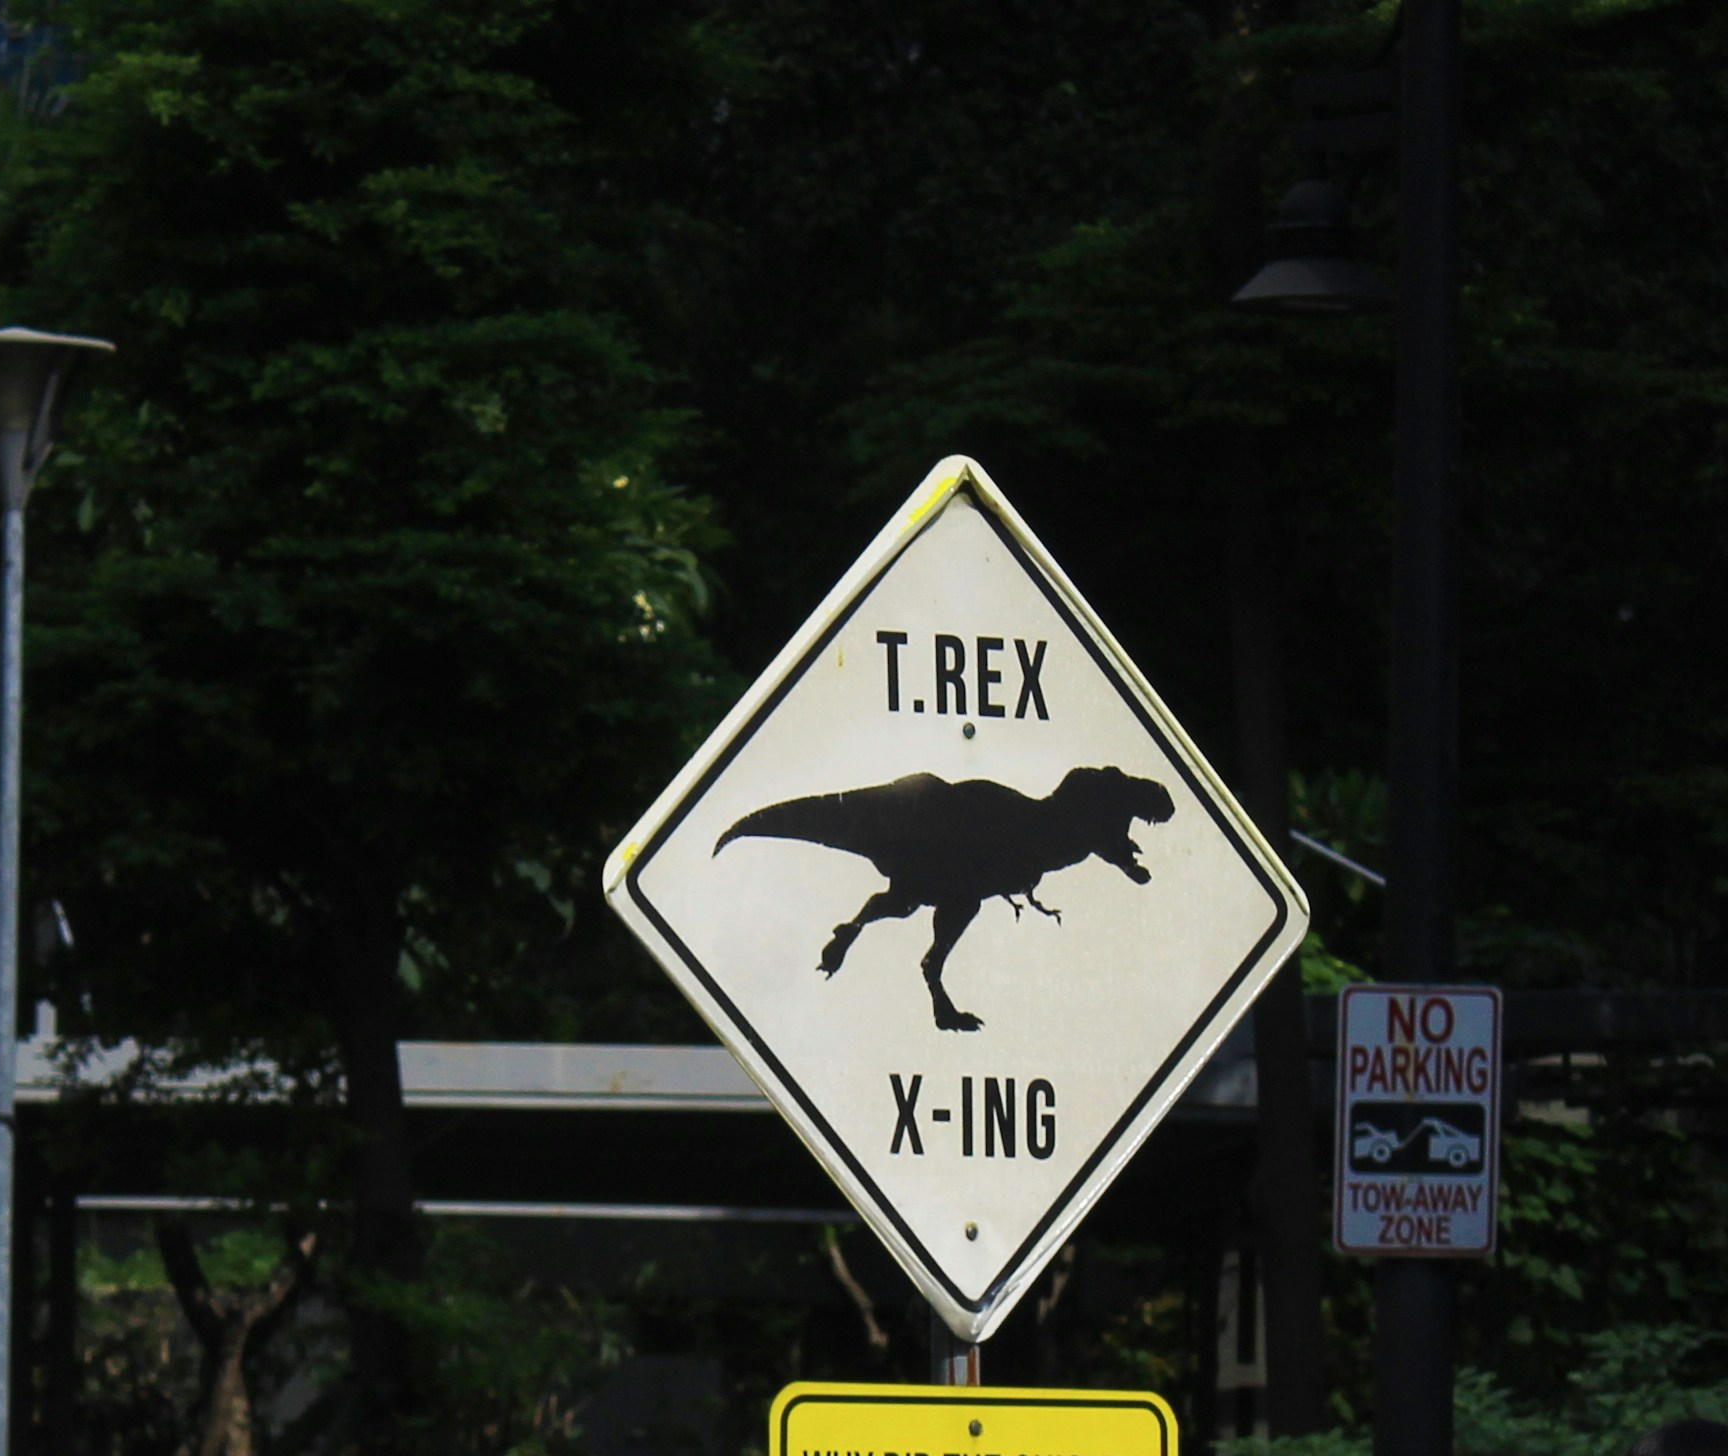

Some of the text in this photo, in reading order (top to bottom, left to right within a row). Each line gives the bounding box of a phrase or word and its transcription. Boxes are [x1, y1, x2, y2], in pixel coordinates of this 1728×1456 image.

[876, 630, 1050, 721] T.REX
[1387, 997, 1455, 1043] NO
[1350, 1045, 1488, 1095] PARKING
[889, 1073, 1056, 1160] X-ING
[1349, 1182, 1483, 1212] TOW-AWAY
[1378, 1214, 1451, 1245] ZONE
